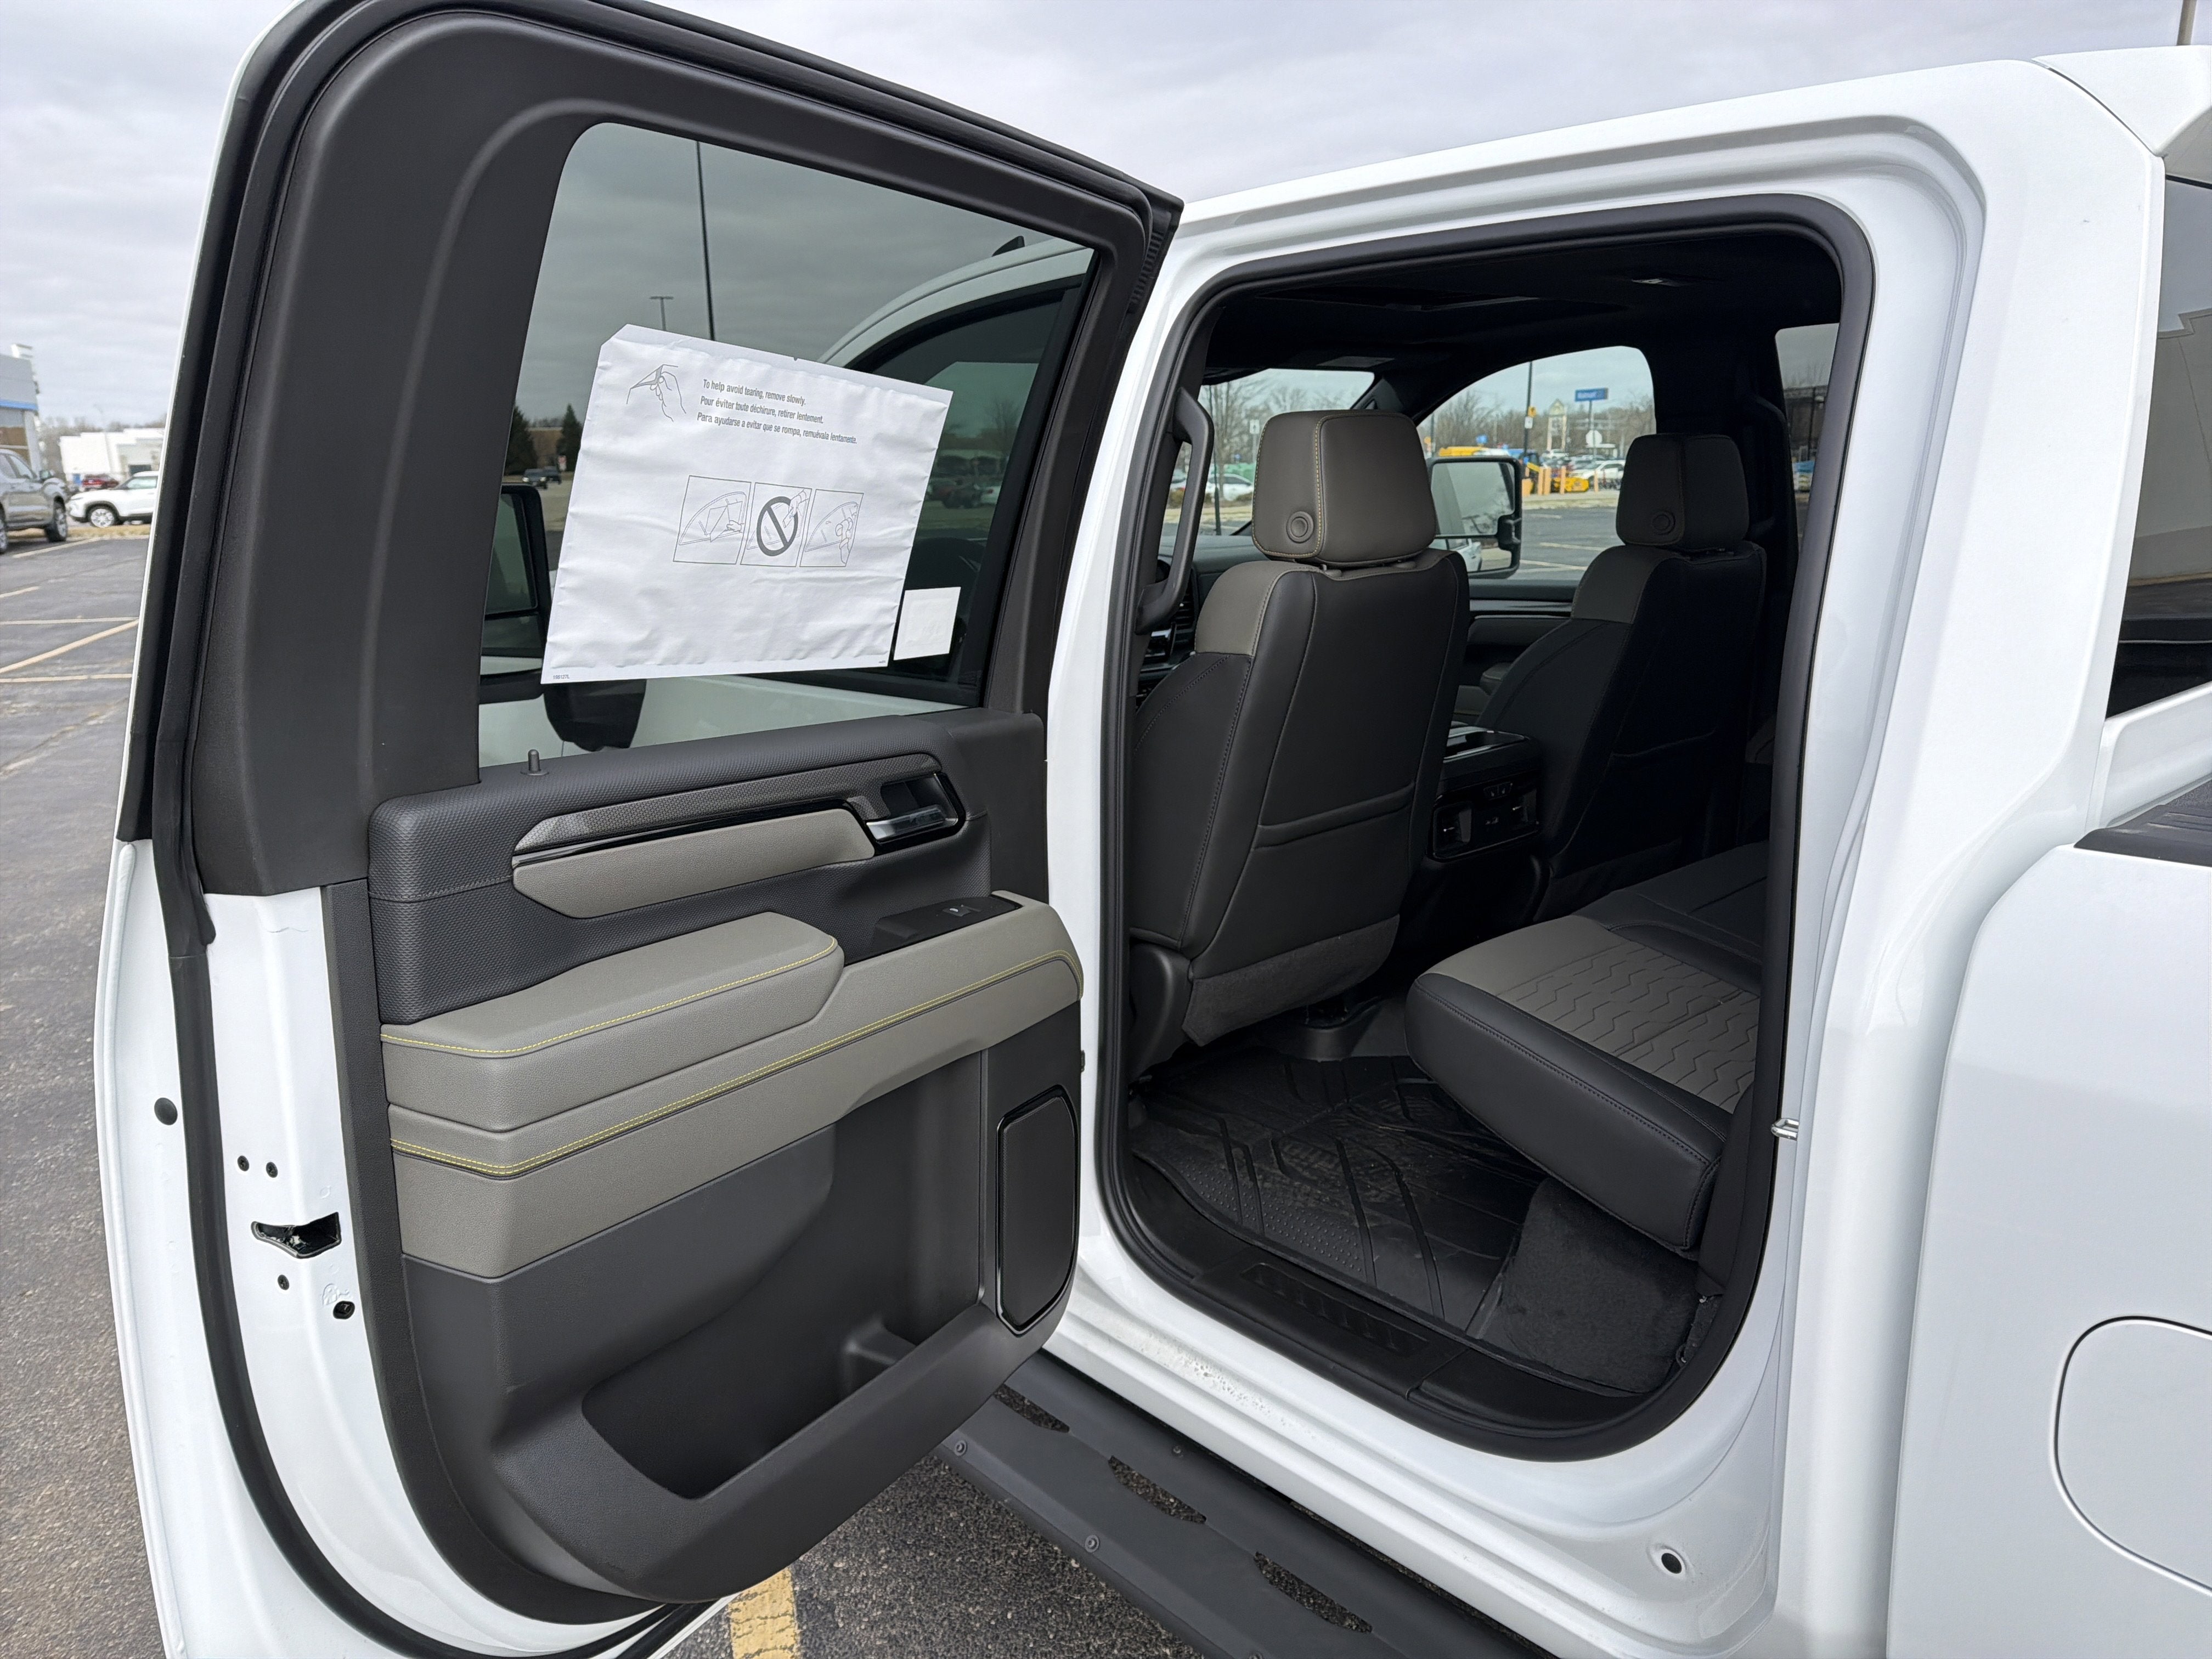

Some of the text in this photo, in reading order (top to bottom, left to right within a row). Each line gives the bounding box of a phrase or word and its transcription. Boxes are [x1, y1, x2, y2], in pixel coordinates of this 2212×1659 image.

[703, 379, 806, 406] To help avoid tearing, remove slowly.
[701, 396, 823, 424] Pour éviter toute déchirure, retirer lentement.
[697, 412, 712, 422] Para
[714, 416, 740, 427] ayudarse
[747, 420, 762, 430] evitar
[763, 423, 772, 432] que
[782, 426, 802, 437] rompa,
[803, 430, 829, 440] remuévala
